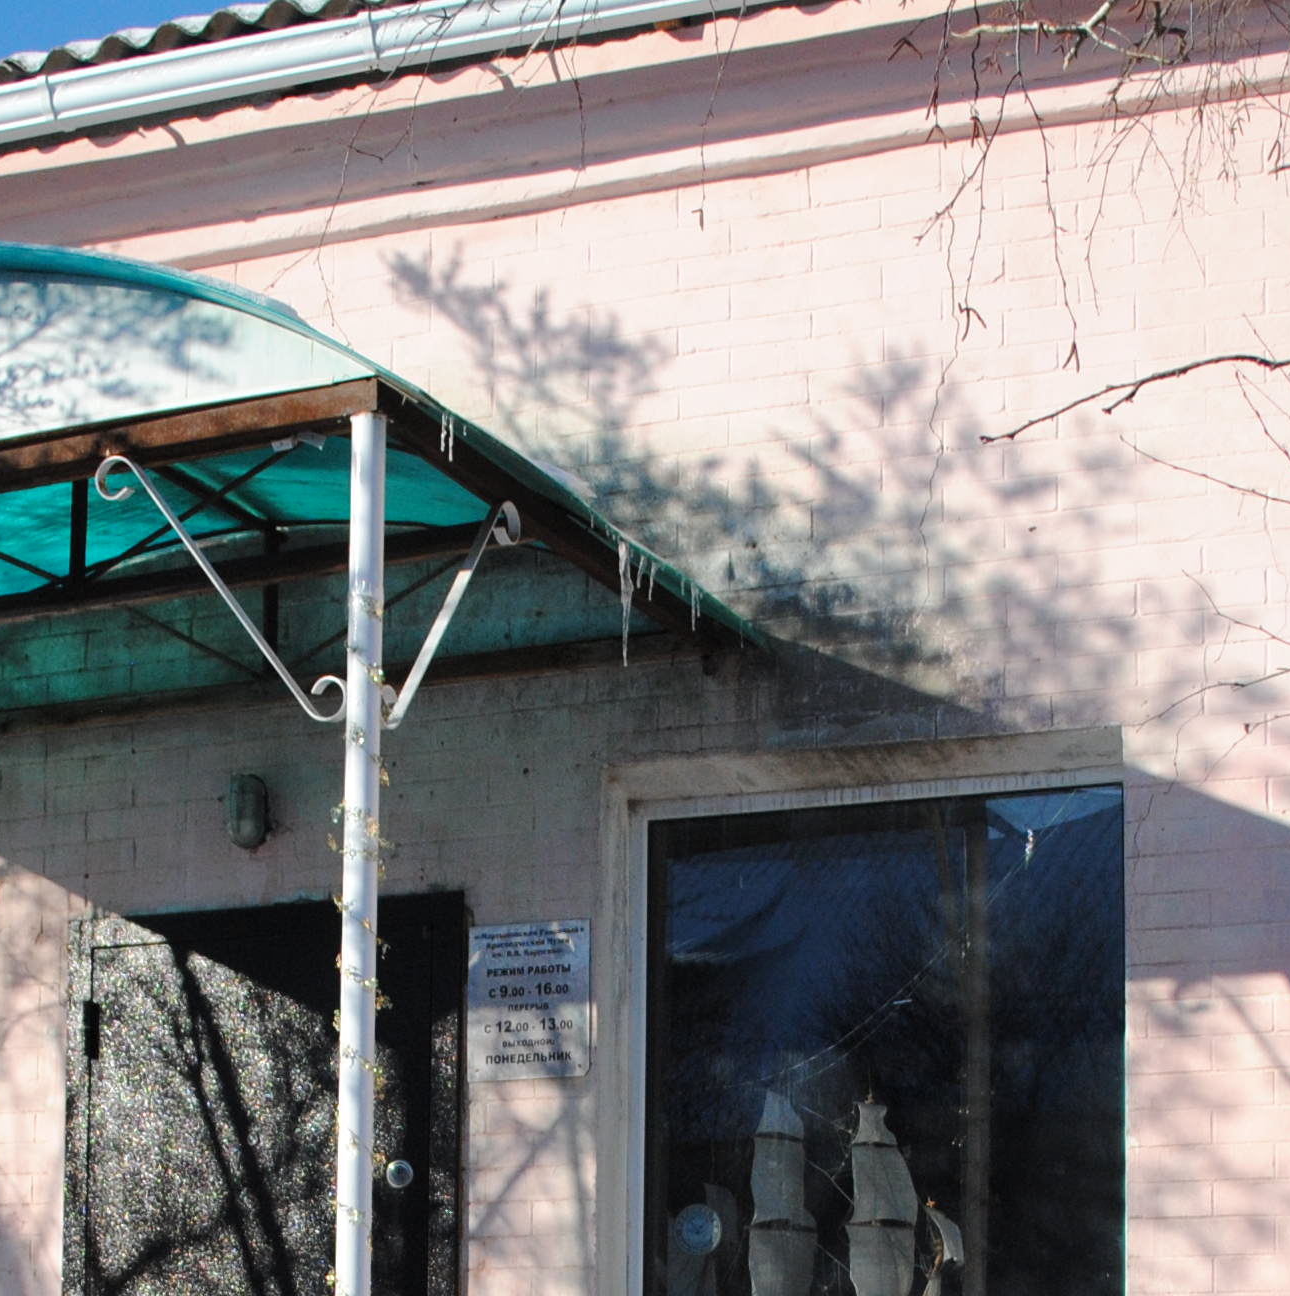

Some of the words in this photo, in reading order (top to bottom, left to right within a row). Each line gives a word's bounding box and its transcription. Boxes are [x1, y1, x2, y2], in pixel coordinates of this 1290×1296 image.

[487, 967, 525, 978] РЕЖИМ
[527, 964, 571, 975] РАБОТЫ
[499, 985, 525, 998] 9.00
[535, 982, 569, 997] 16.00
[507, 1002, 549, 1012] ПЕРЕРЫВ
[495, 1020, 529, 1033] 12.00
[540, 1018, 573, 1031] 13.00
[485, 1051, 572, 1065] ПОНЕДЕЛЬНИК
